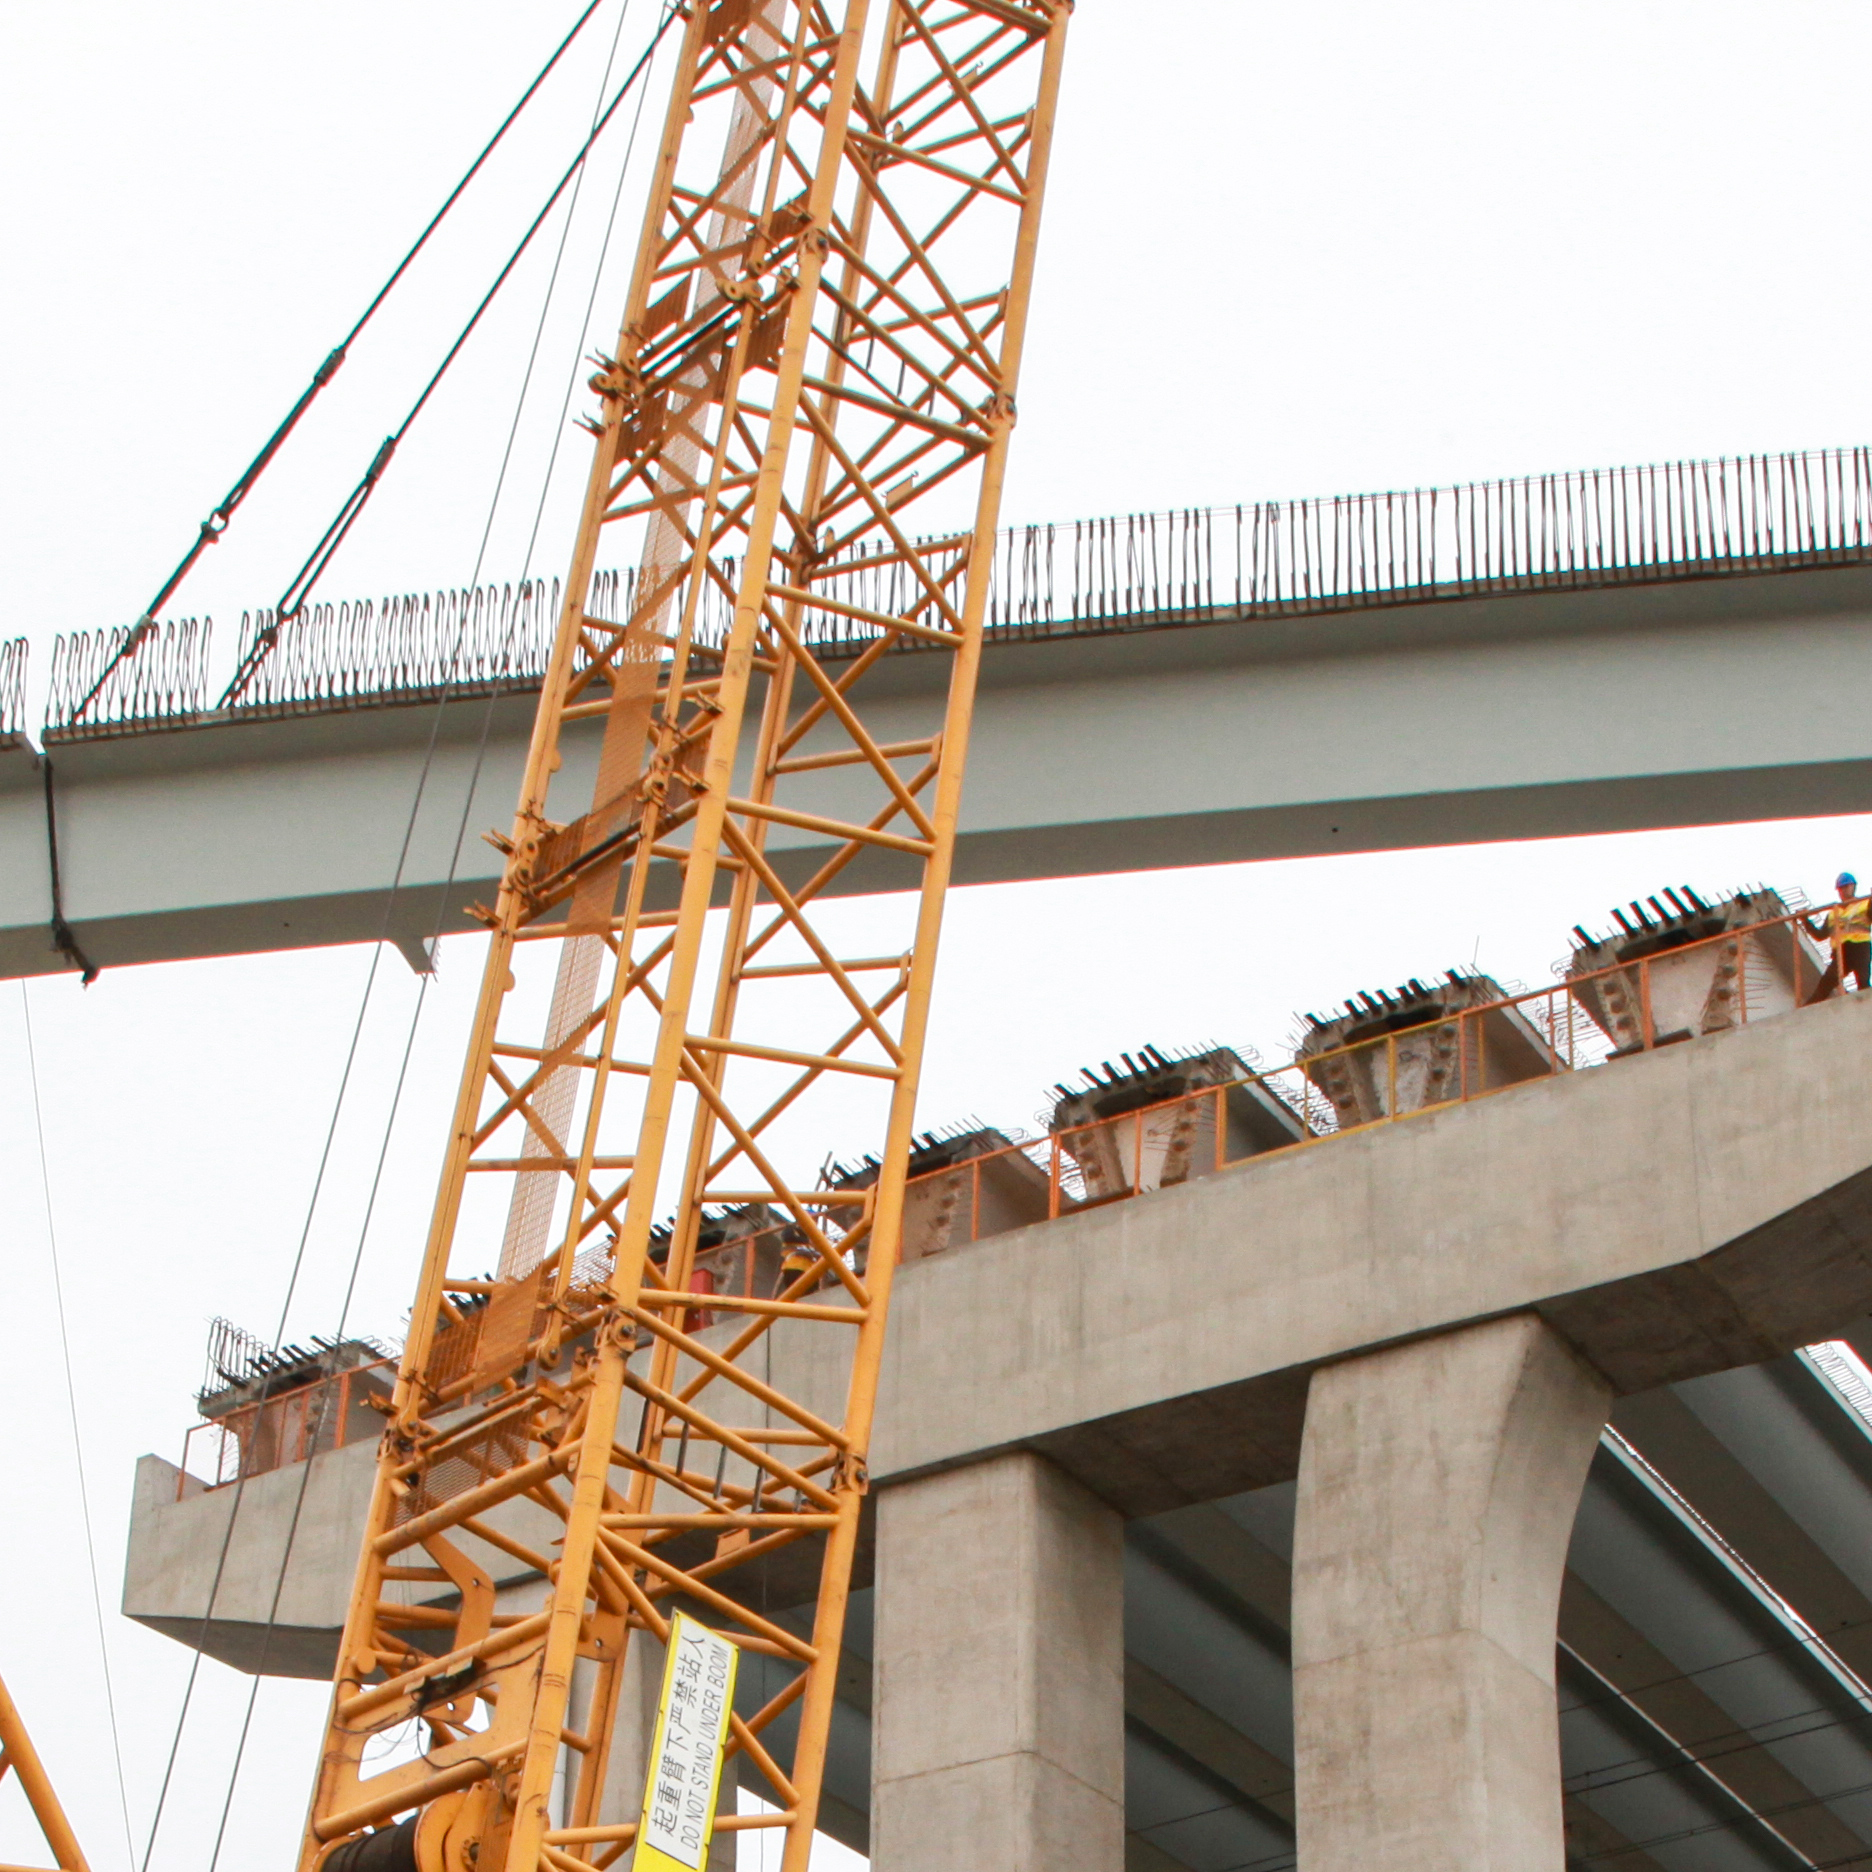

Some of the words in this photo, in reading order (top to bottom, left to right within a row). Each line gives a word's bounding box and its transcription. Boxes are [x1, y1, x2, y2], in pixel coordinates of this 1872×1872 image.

[712, 1643, 728, 1689] BOOM
[651, 1636, 706, 1836] 起重臂下严禁站人
[699, 1691, 722, 1743] UNDER
[692, 1745, 714, 1790] STAND
[685, 1790, 706, 1823] NOT
[681, 1826, 701, 1850] DO
